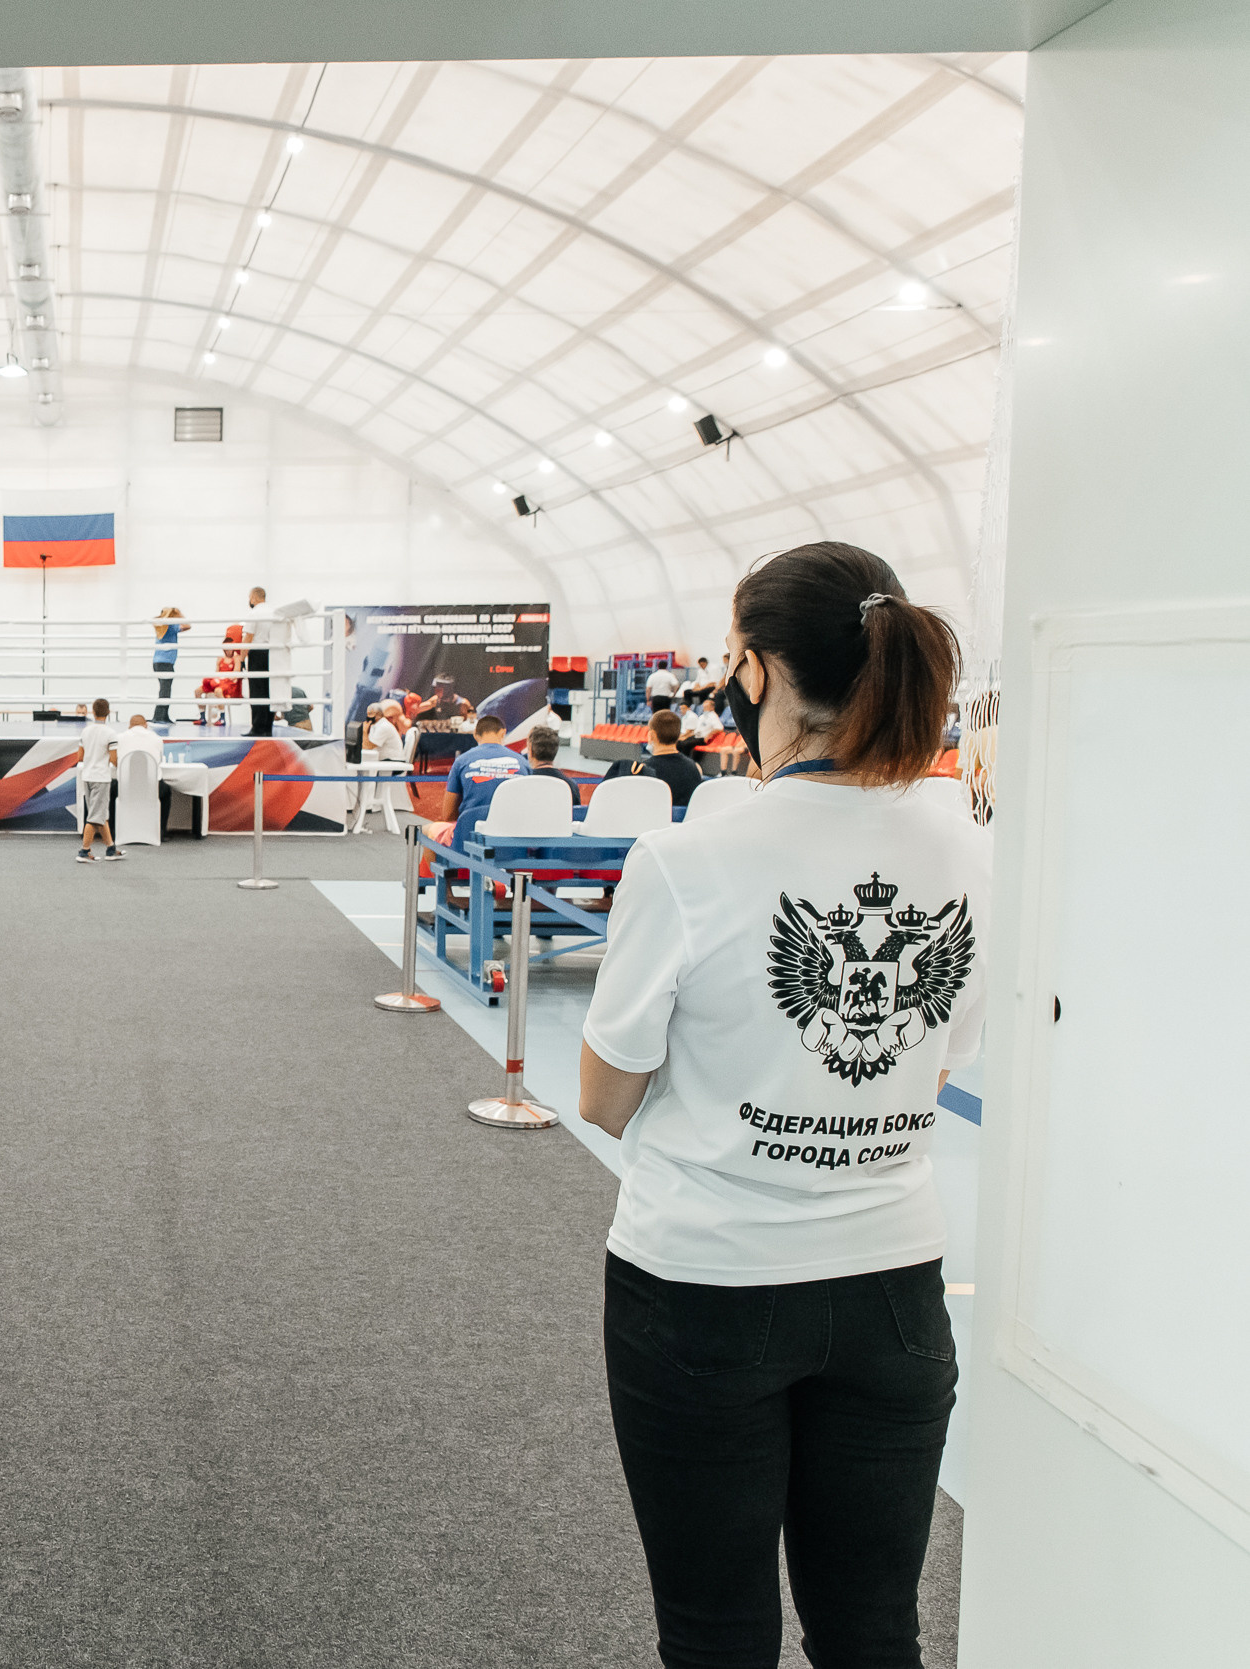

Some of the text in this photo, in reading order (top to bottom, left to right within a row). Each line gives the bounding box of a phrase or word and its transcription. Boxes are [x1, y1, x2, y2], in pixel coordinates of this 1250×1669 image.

[738, 1101, 879, 1139] ФЕДЕРАЦИЯ
[751, 1140, 911, 1170] ГОРОДА СОЧИ
